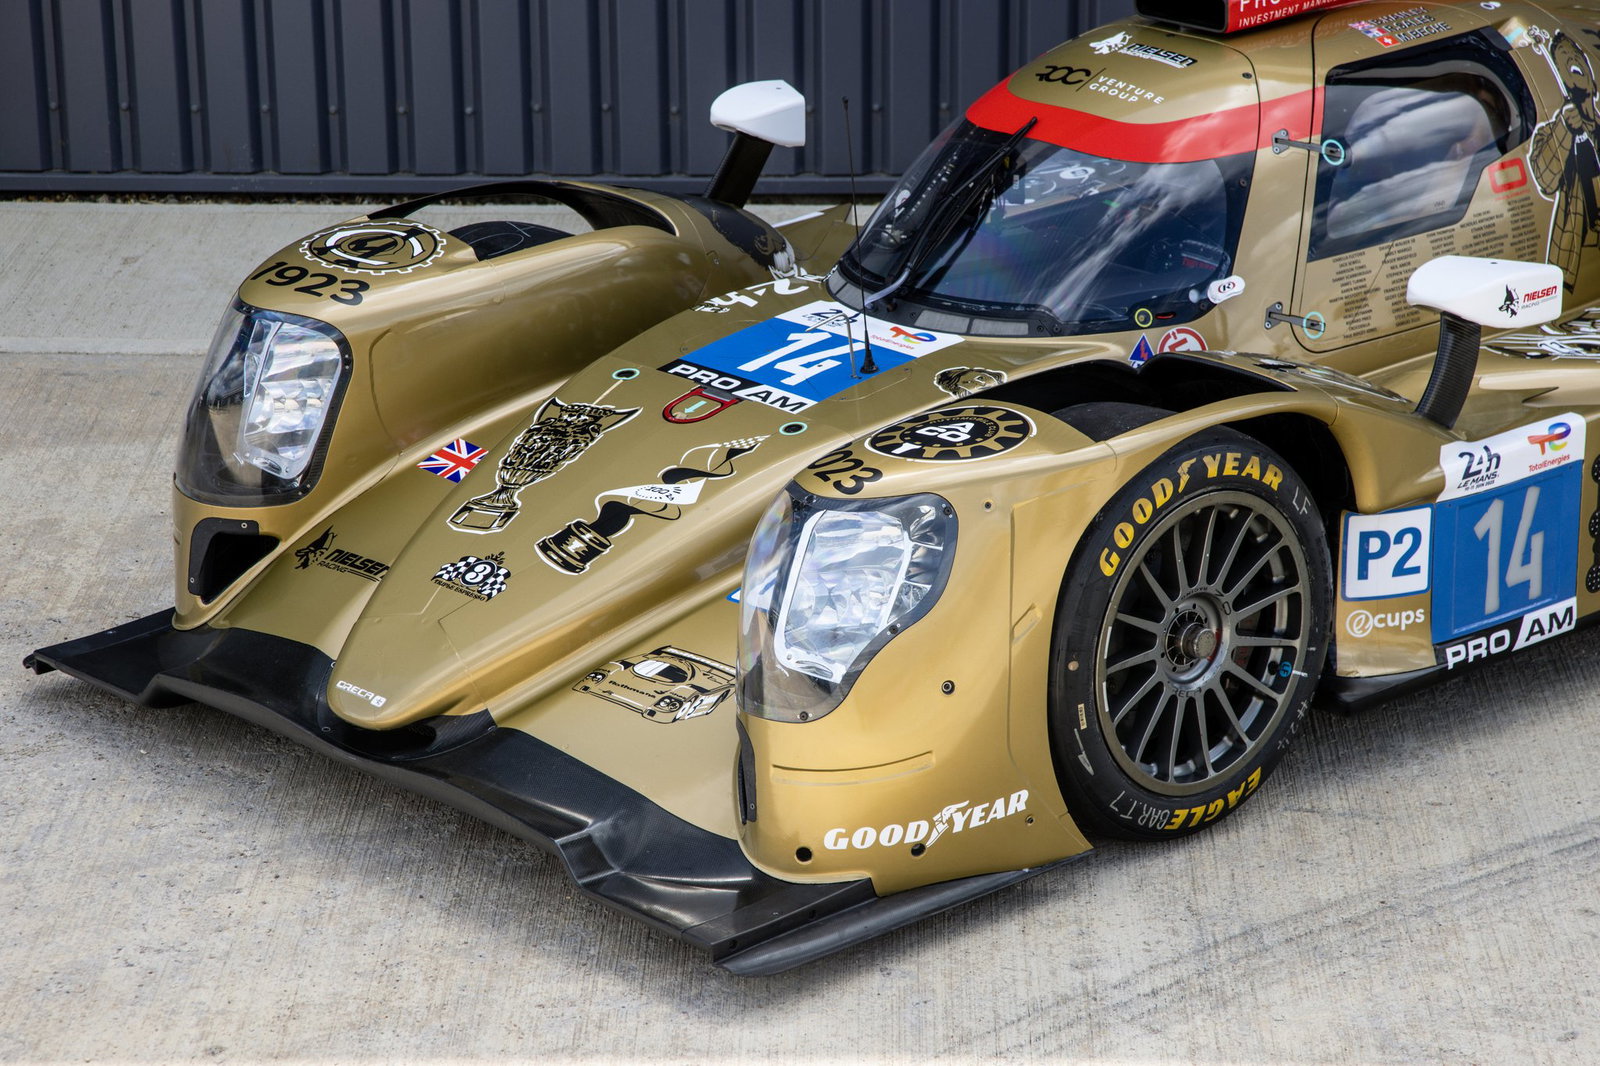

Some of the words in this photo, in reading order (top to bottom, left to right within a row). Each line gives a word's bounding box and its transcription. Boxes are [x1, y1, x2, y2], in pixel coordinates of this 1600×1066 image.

[1238, 4, 1300, 28] INVESTMENT
[1396, 22, 1454, 43] M.BECHE
[1126, 43, 1197, 68] NIELSEN
[1088, 82, 1139, 103] GROUP
[1098, 75, 1165, 105] VENTURE
[250, 261, 371, 306] 1923
[1522, 285, 1558, 304] NIELSEN
[736, 331, 866, 387] 14
[667, 363, 742, 391] PRO
[745, 389, 809, 413] AM
[806, 442, 884, 496] 023
[1528, 453, 1571, 473] TotalEnergies
[1457, 478, 1469, 490] LE
[1470, 470, 1499, 486] MANS
[1357, 526, 1423, 581] P2
[1473, 485, 1545, 616] 14
[316, 560, 349, 574] RACING
[1445, 628, 1512, 670] PRO
[1524, 605, 1575, 643] AM
[335, 680, 375, 701] ORECA
[1163, 766, 1262, 830] EAGLE
